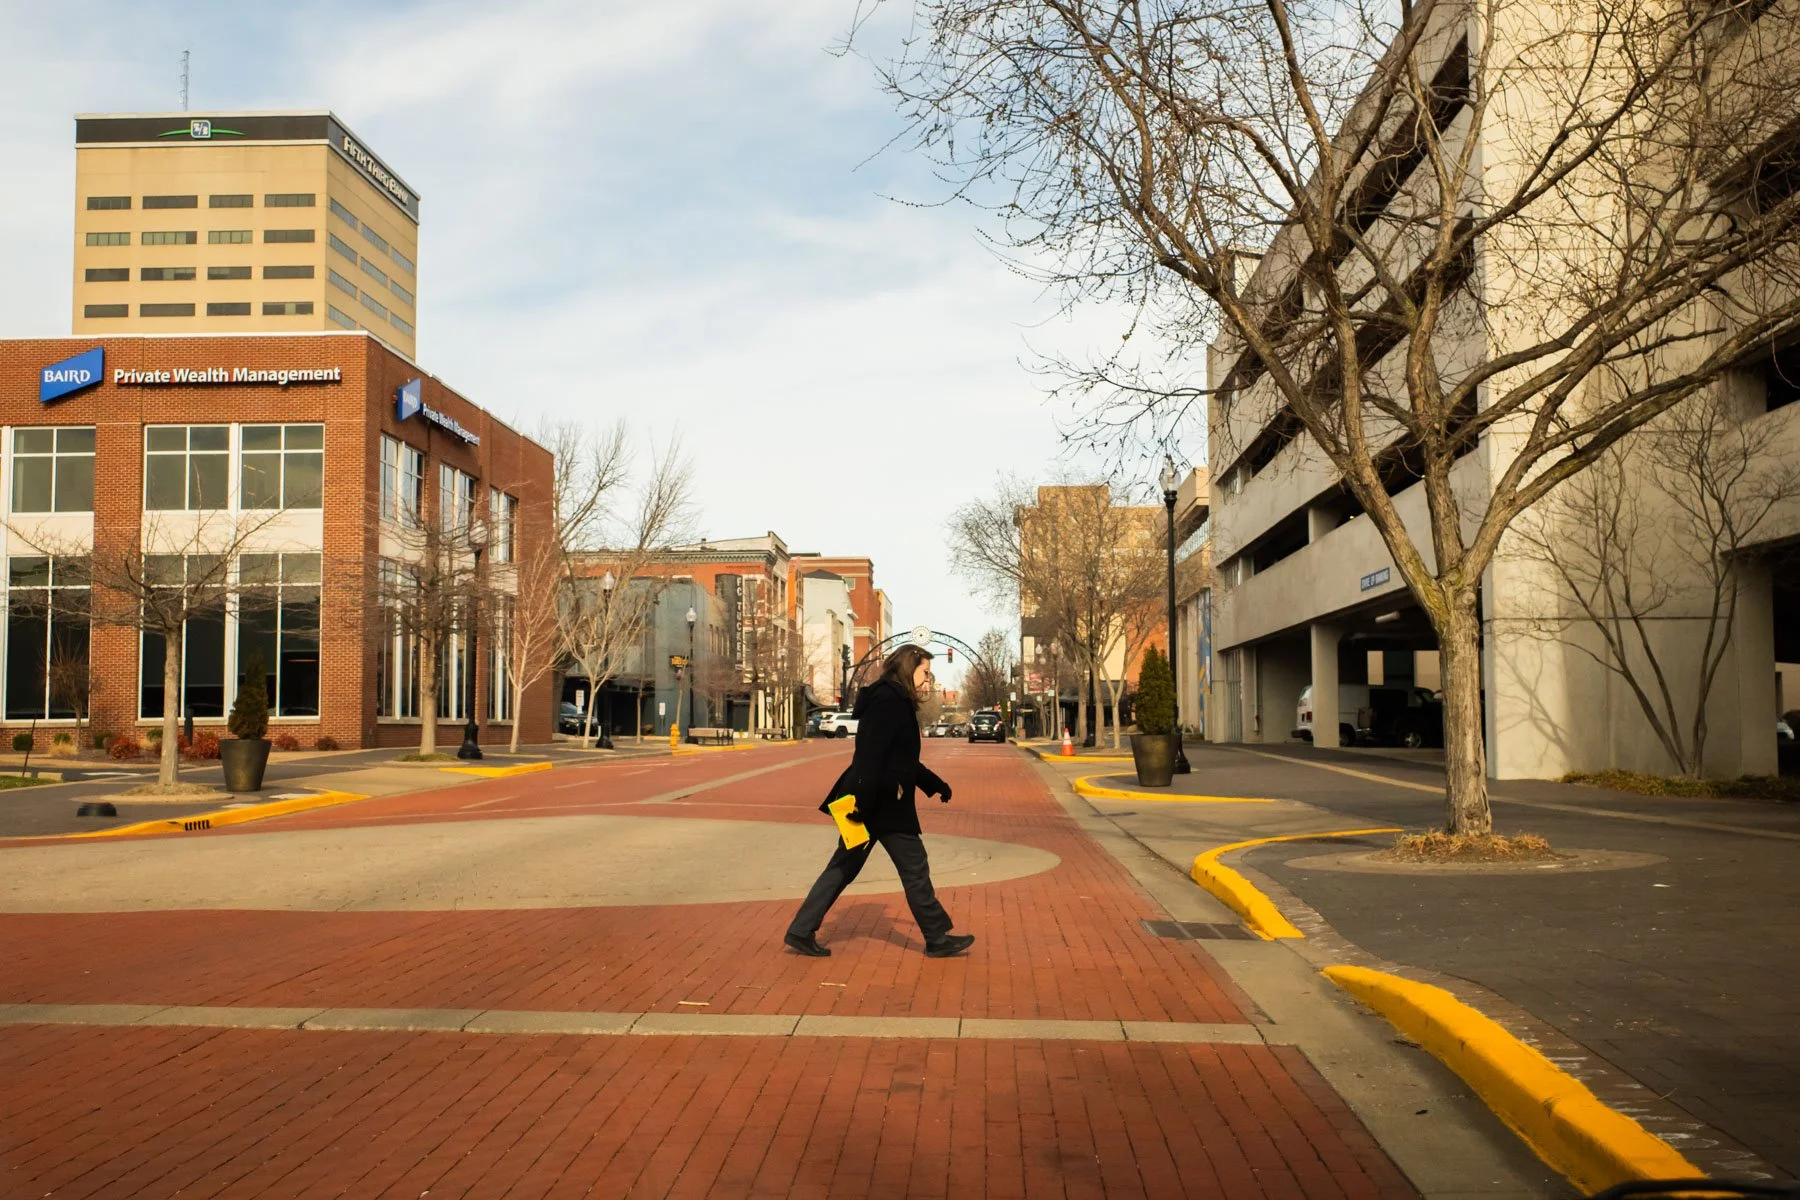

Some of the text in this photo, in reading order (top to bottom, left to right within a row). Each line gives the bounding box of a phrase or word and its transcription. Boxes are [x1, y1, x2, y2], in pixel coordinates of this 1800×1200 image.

[343, 136, 408, 206] FIFTH THIRD BANK
[44, 367, 340, 386] BAIRD Private Wealth Management
